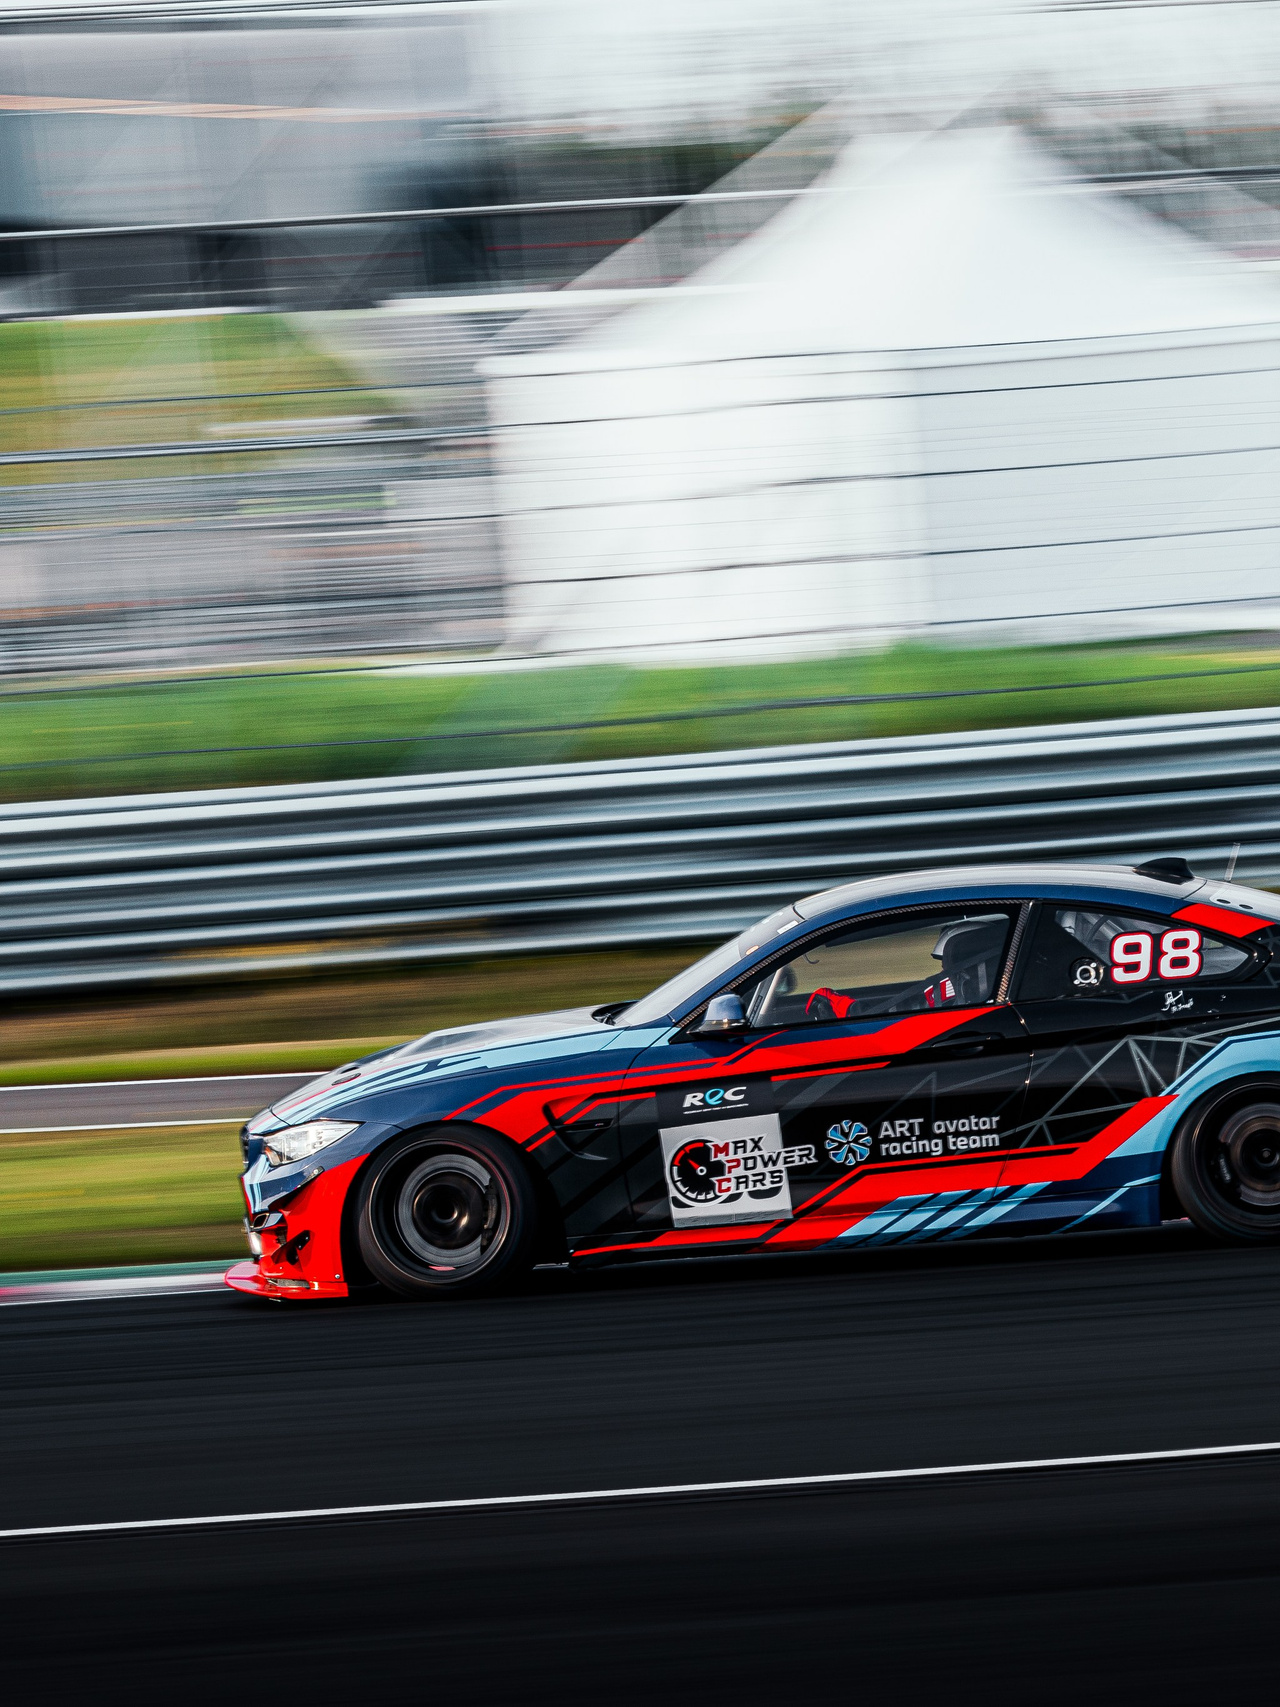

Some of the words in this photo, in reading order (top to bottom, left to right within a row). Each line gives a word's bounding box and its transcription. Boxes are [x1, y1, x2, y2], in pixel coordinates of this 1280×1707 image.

[1110, 928, 1202, 984] 98
[878, 1118, 924, 1138] ART
[933, 1115, 1000, 1134] avatar
[711, 1136, 764, 1159] MAX
[880, 1136, 943, 1156] racing
[947, 1133, 1000, 1150] team
[725, 1147, 813, 1174] POWER
[715, 1169, 784, 1194] CARS
